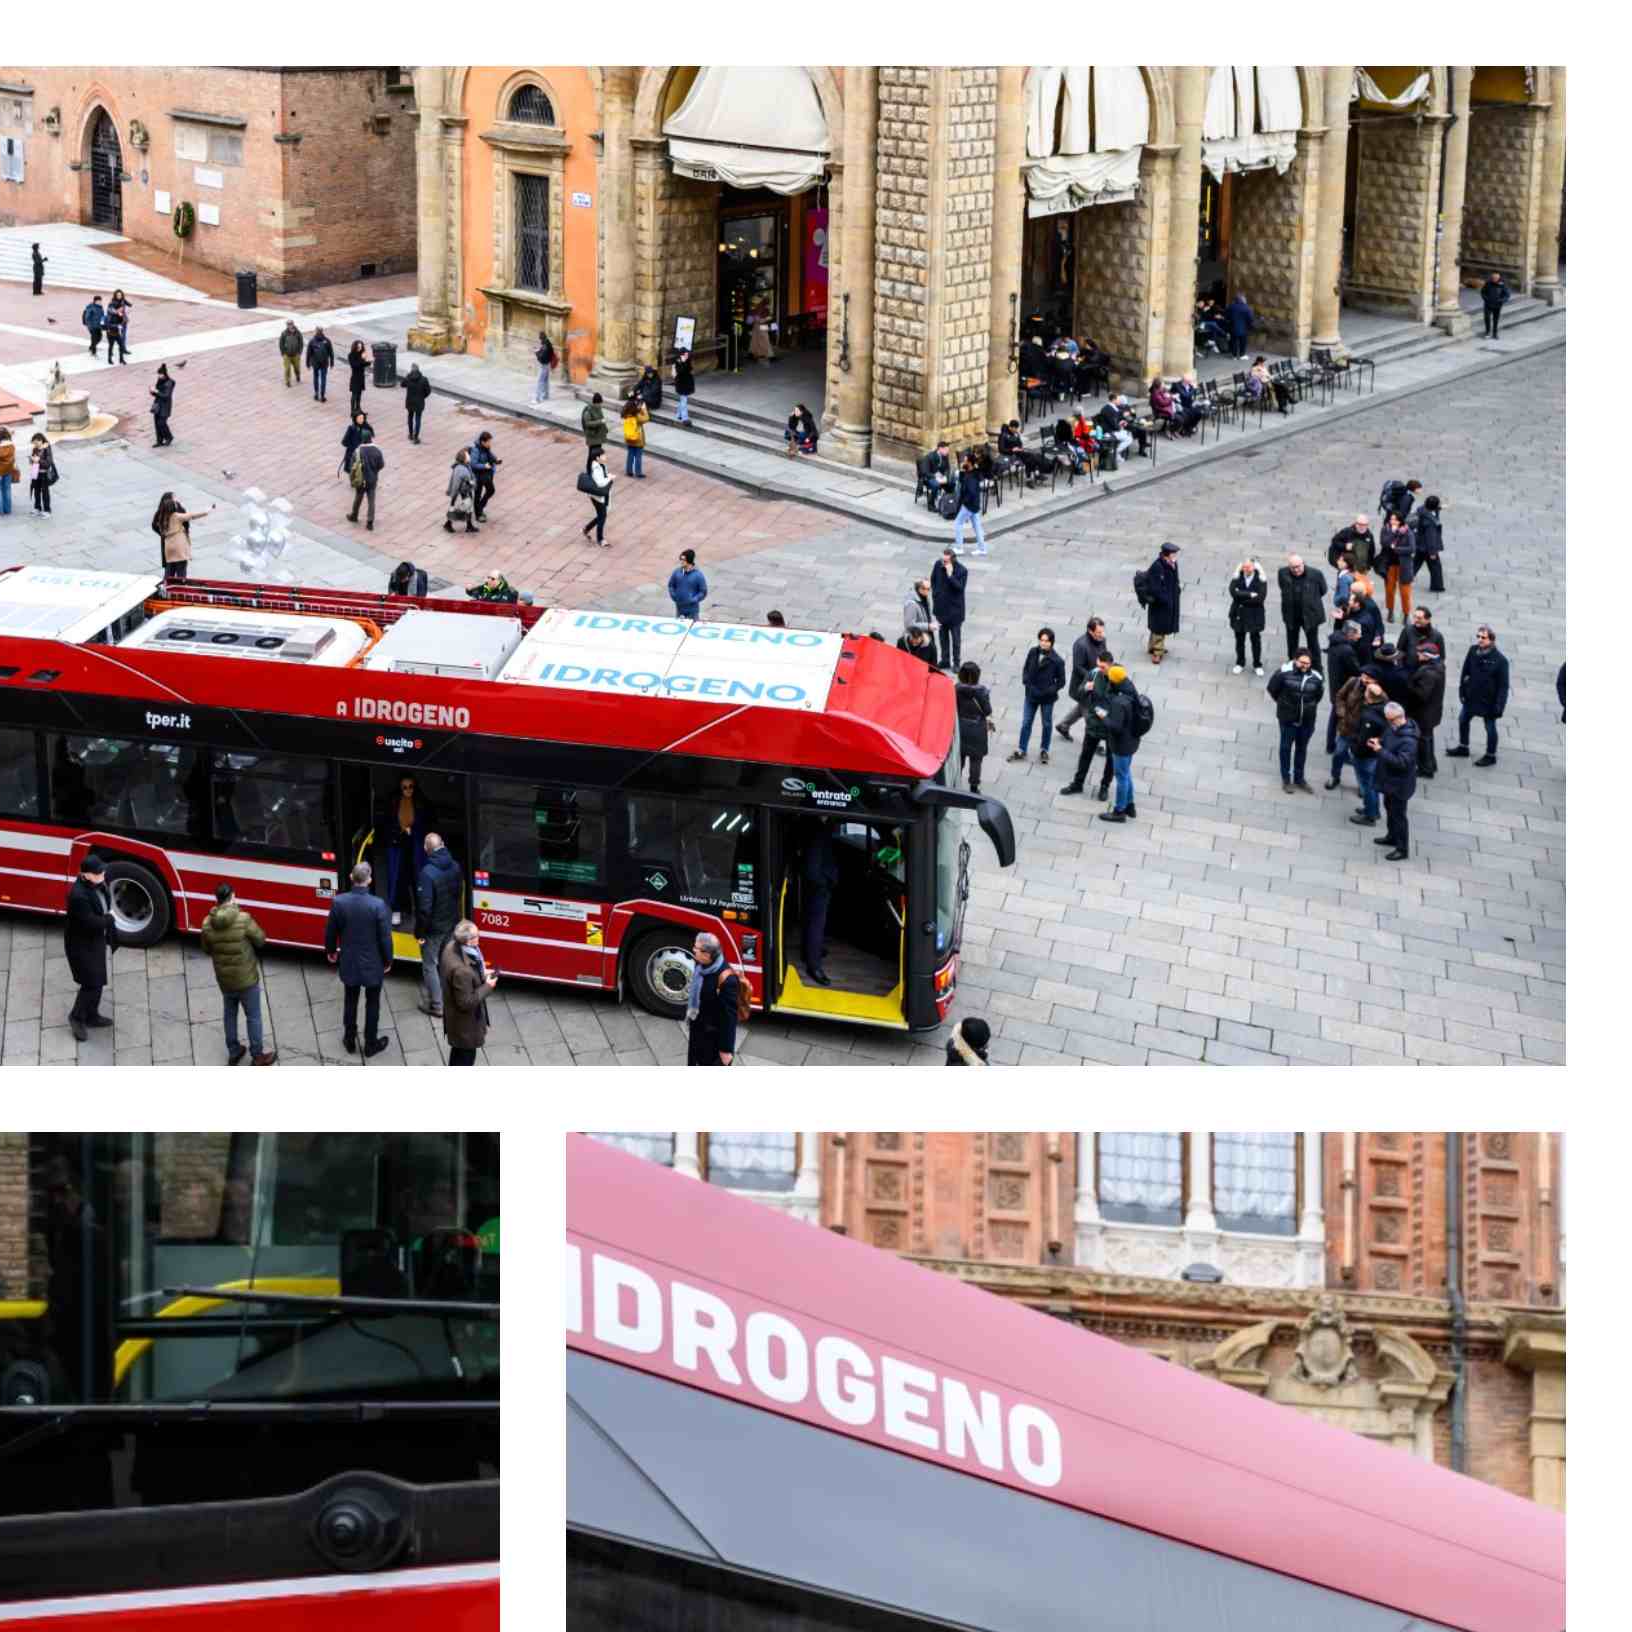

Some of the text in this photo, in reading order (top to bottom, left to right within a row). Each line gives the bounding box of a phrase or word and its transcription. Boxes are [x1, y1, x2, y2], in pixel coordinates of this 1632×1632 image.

[574, 615, 823, 647] IDROGENO
[538, 663, 806, 702] IDROGENO
[146, 710, 192, 731] tper.it
[354, 697, 470, 728] IDROGENO
[481, 912, 510, 927] 7082
[566, 1242, 1062, 1487] IDROGENO
